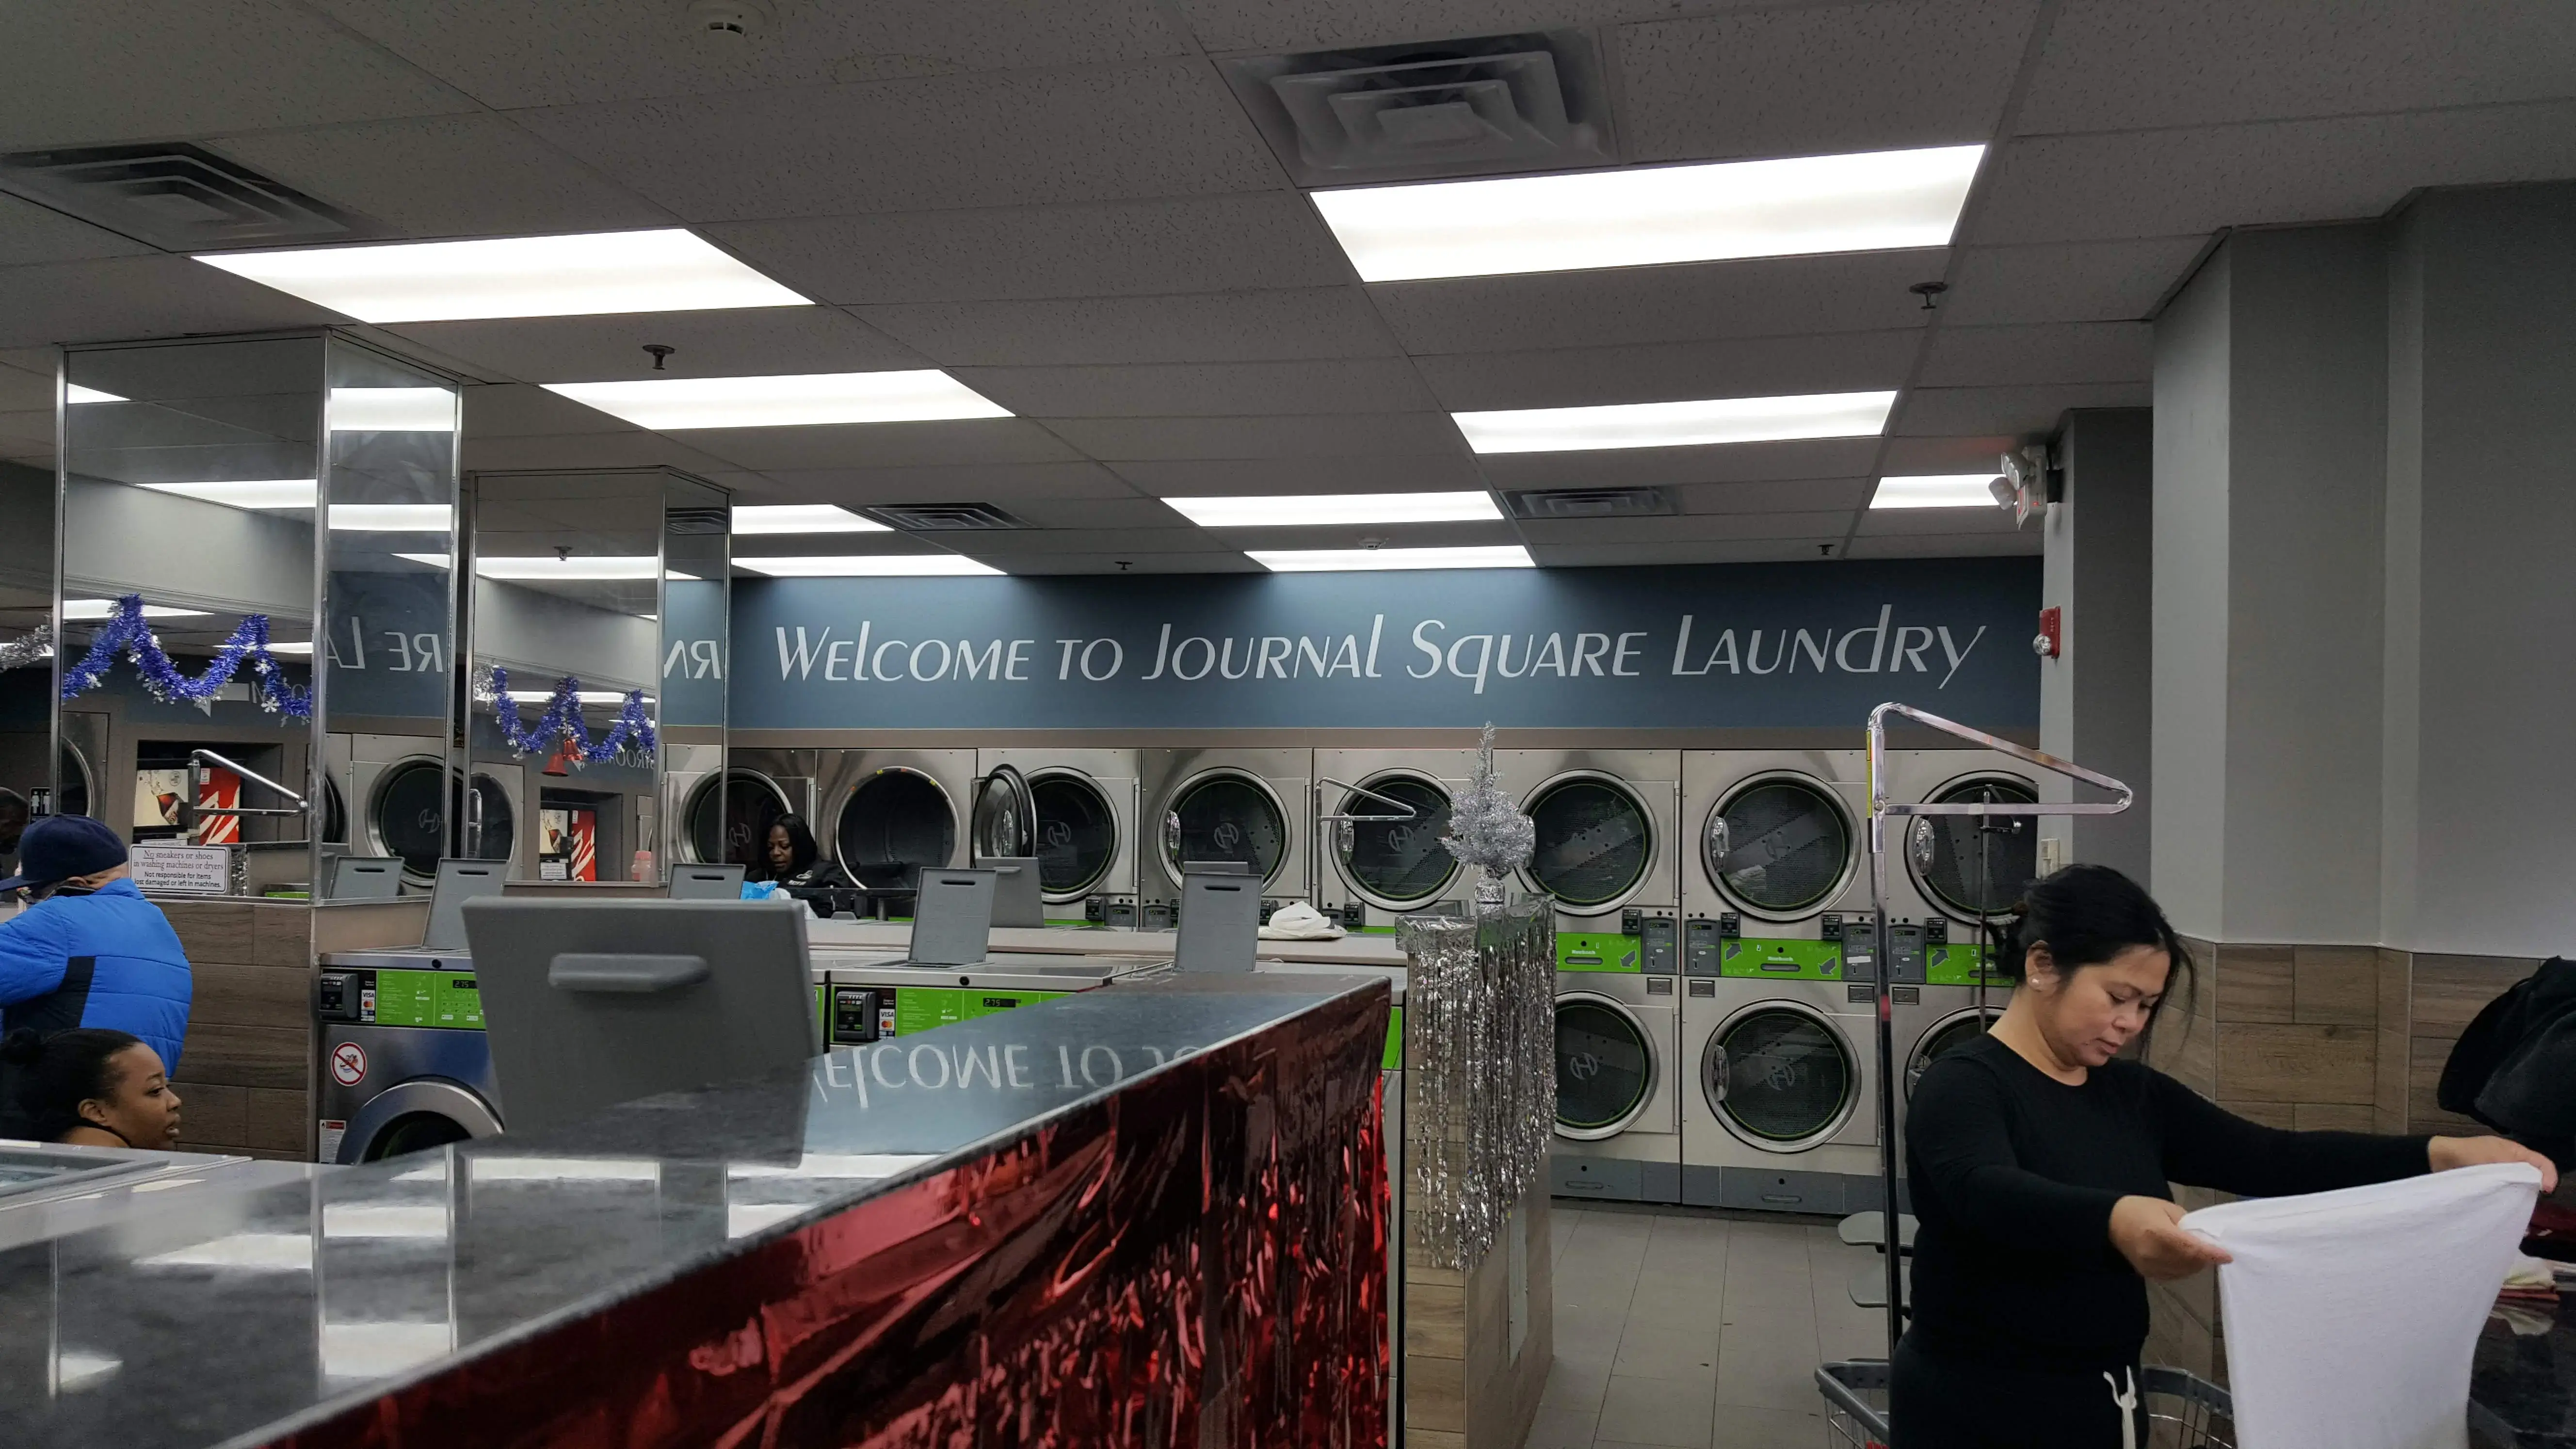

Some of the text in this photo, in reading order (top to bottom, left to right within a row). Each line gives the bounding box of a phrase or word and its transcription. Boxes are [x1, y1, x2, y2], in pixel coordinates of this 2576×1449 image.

[776, 605, 1987, 694] WELCOME TO JOURNAL SQUARE LAUNDRY
[144, 850, 154, 858] No
[195, 851, 213, 859] shoes
[141, 860, 165, 870] washing
[166, 861, 194, 869] machines
[204, 861, 224, 872] dryers
